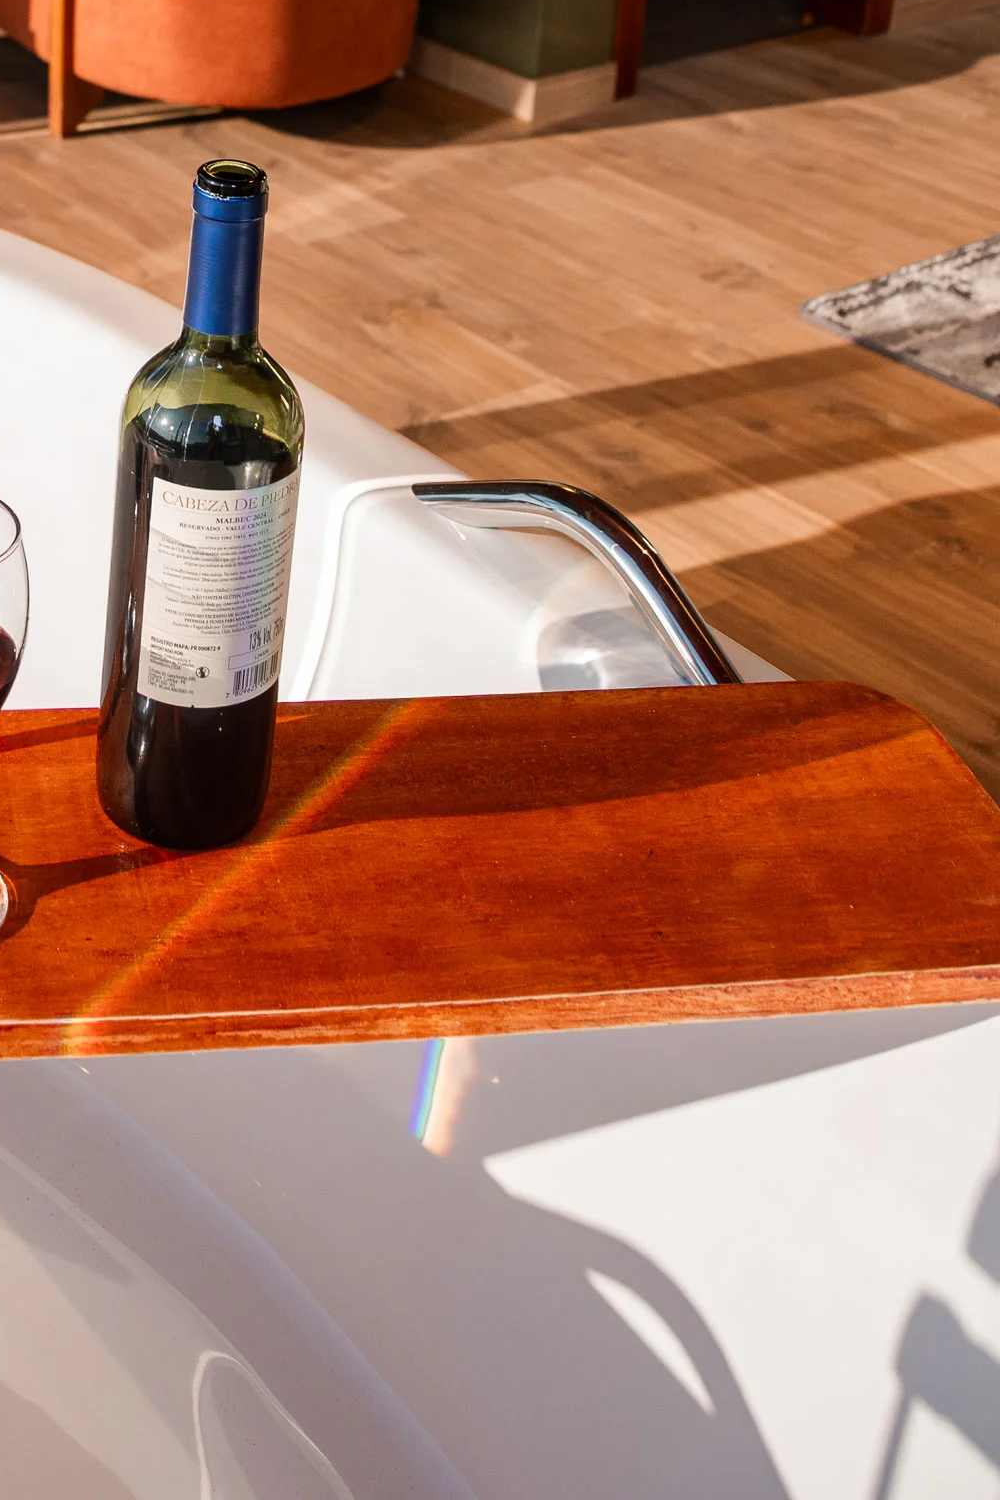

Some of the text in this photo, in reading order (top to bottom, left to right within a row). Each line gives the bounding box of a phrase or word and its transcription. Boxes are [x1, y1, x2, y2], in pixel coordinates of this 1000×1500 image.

[162, 490, 230, 511] CABEZA
[235, 497, 258, 511] DE
[179, 522, 220, 531] RESERVADO
[247, 518, 274, 528] CENTRAL
[216, 515, 251, 524] MALBEC
[151, 635, 173, 647] REGISTRO
[249, 630, 261, 650] 13%
